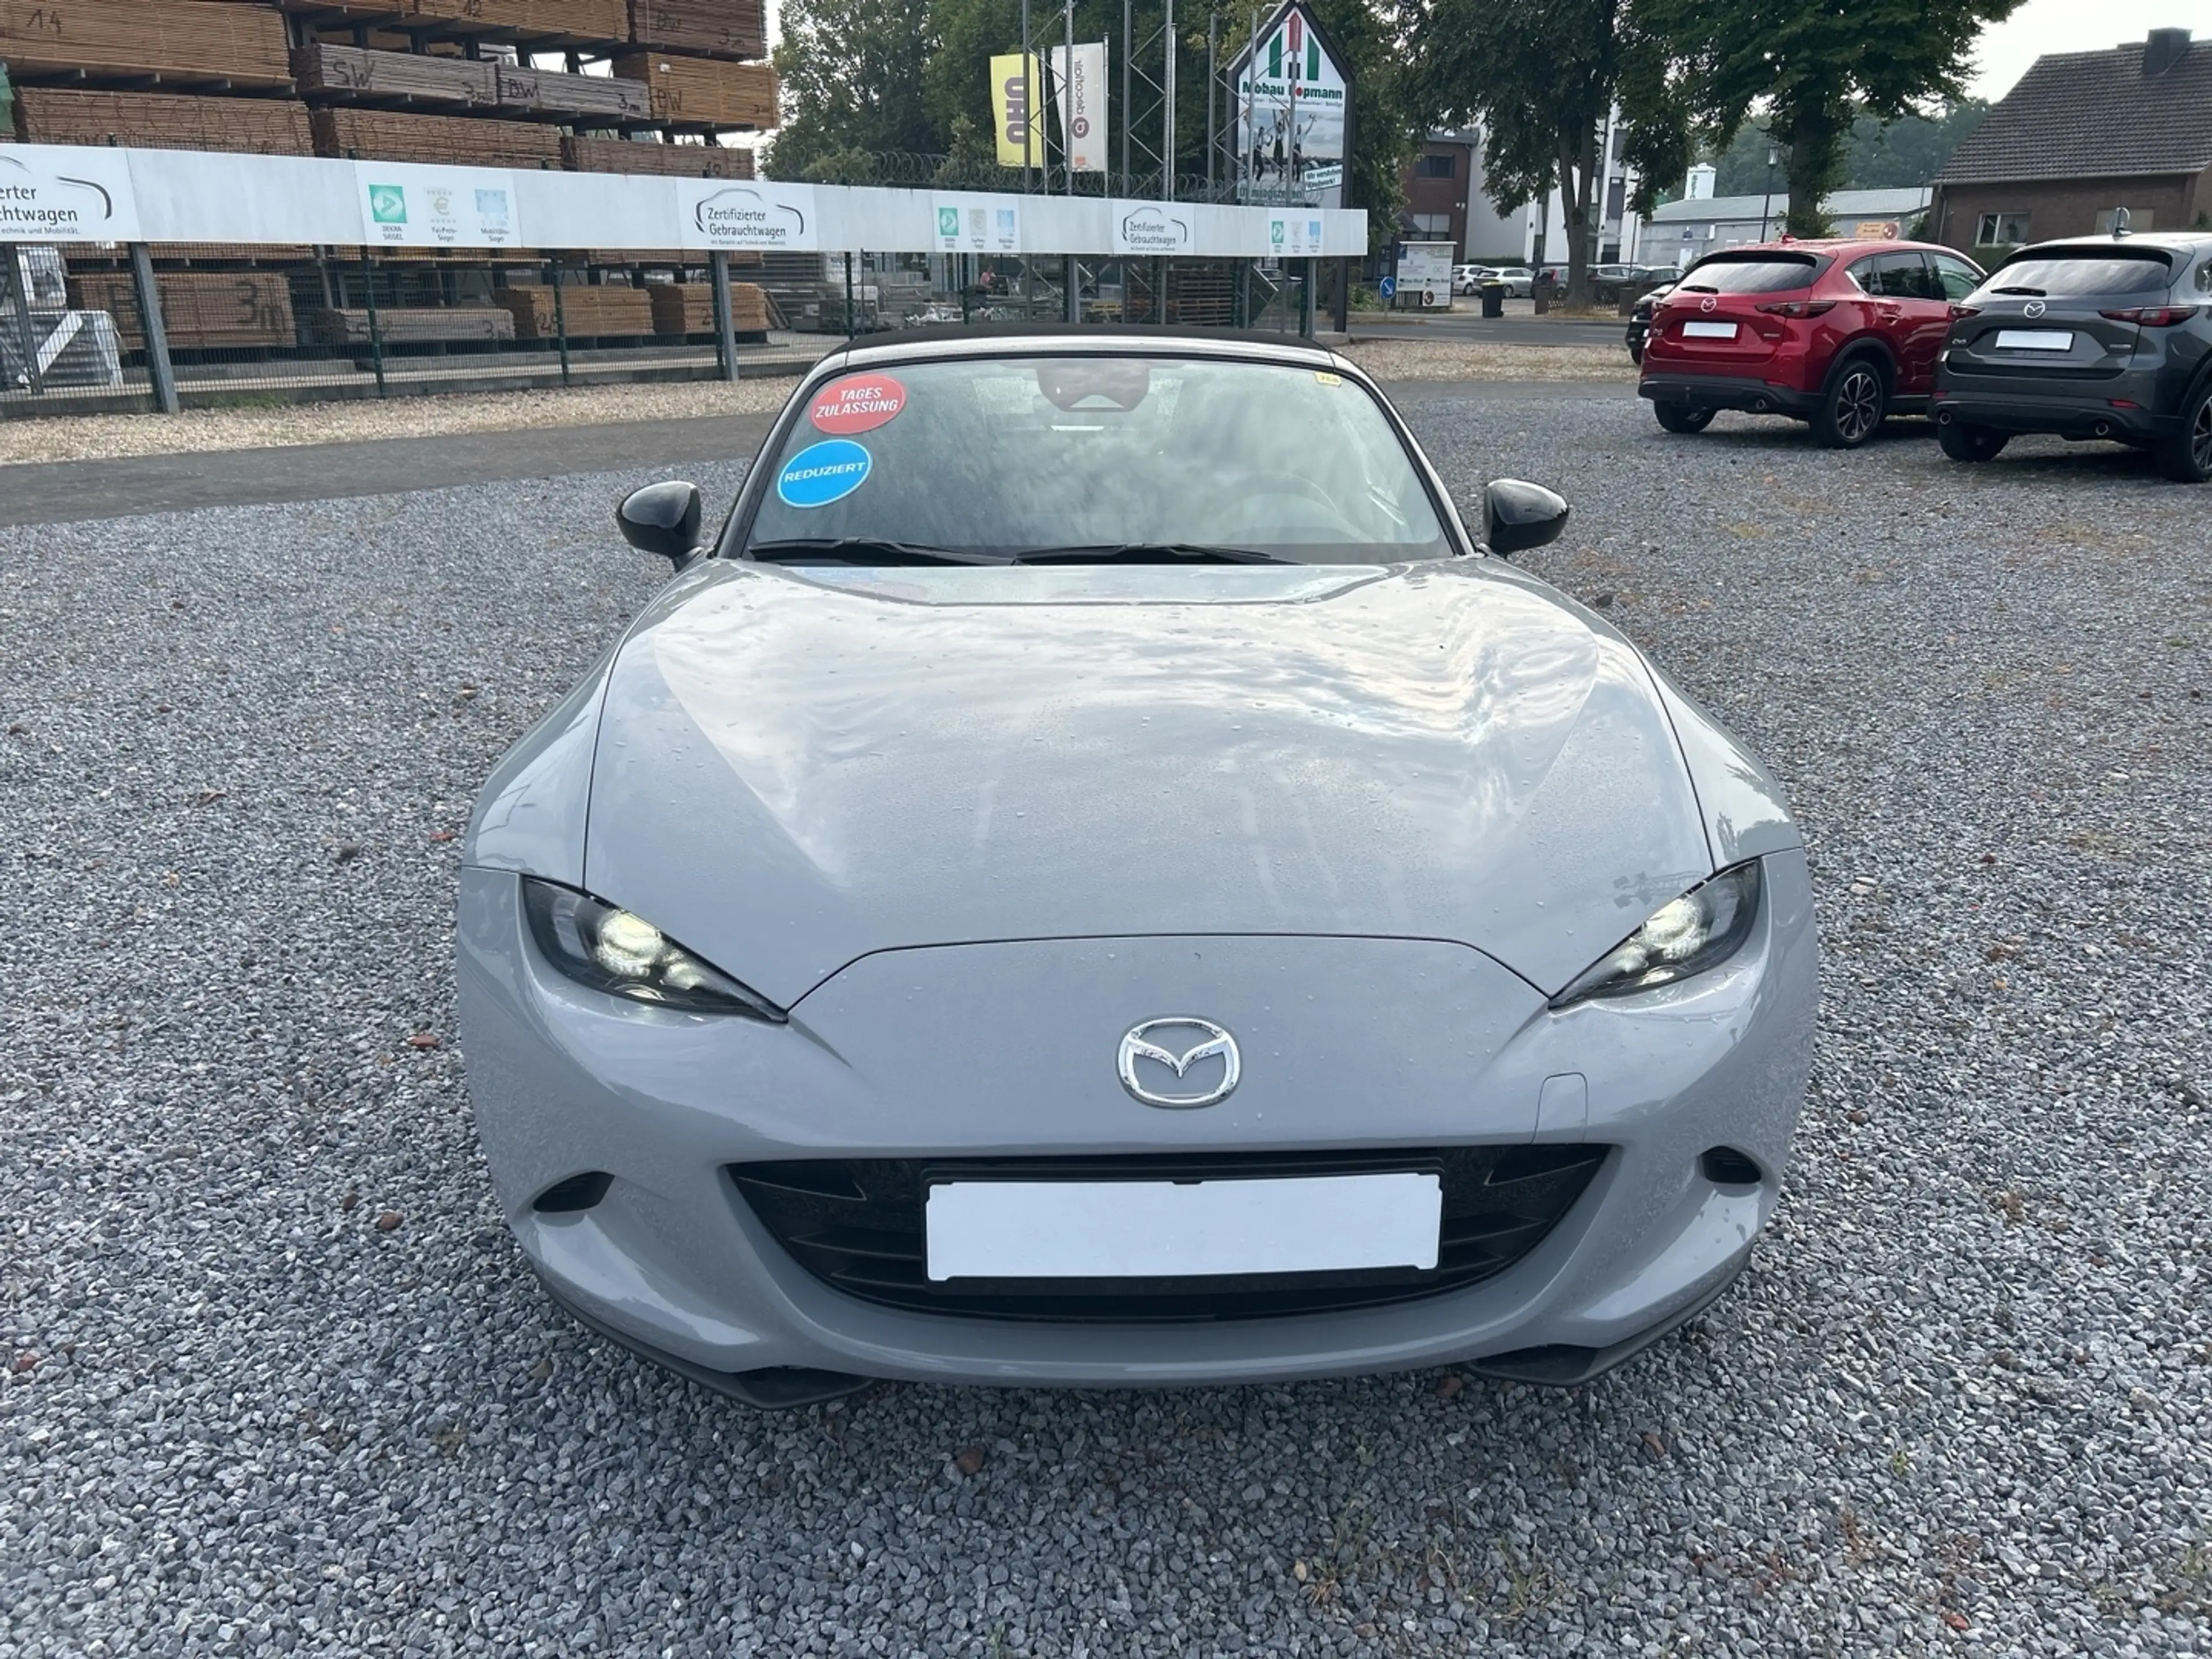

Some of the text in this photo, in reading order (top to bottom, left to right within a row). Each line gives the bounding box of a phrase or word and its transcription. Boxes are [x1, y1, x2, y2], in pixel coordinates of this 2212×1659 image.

[25, 9, 61, 35] 14
[1004, 76, 1025, 144] UHU
[707, 207, 766, 222] Zertifizierter
[709, 223, 786, 239] Gebrauchtwagen
[840, 387, 883, 402] TAGES
[815, 399, 898, 418] ZULASSUNG
[784, 462, 866, 483] REDUZIERT
